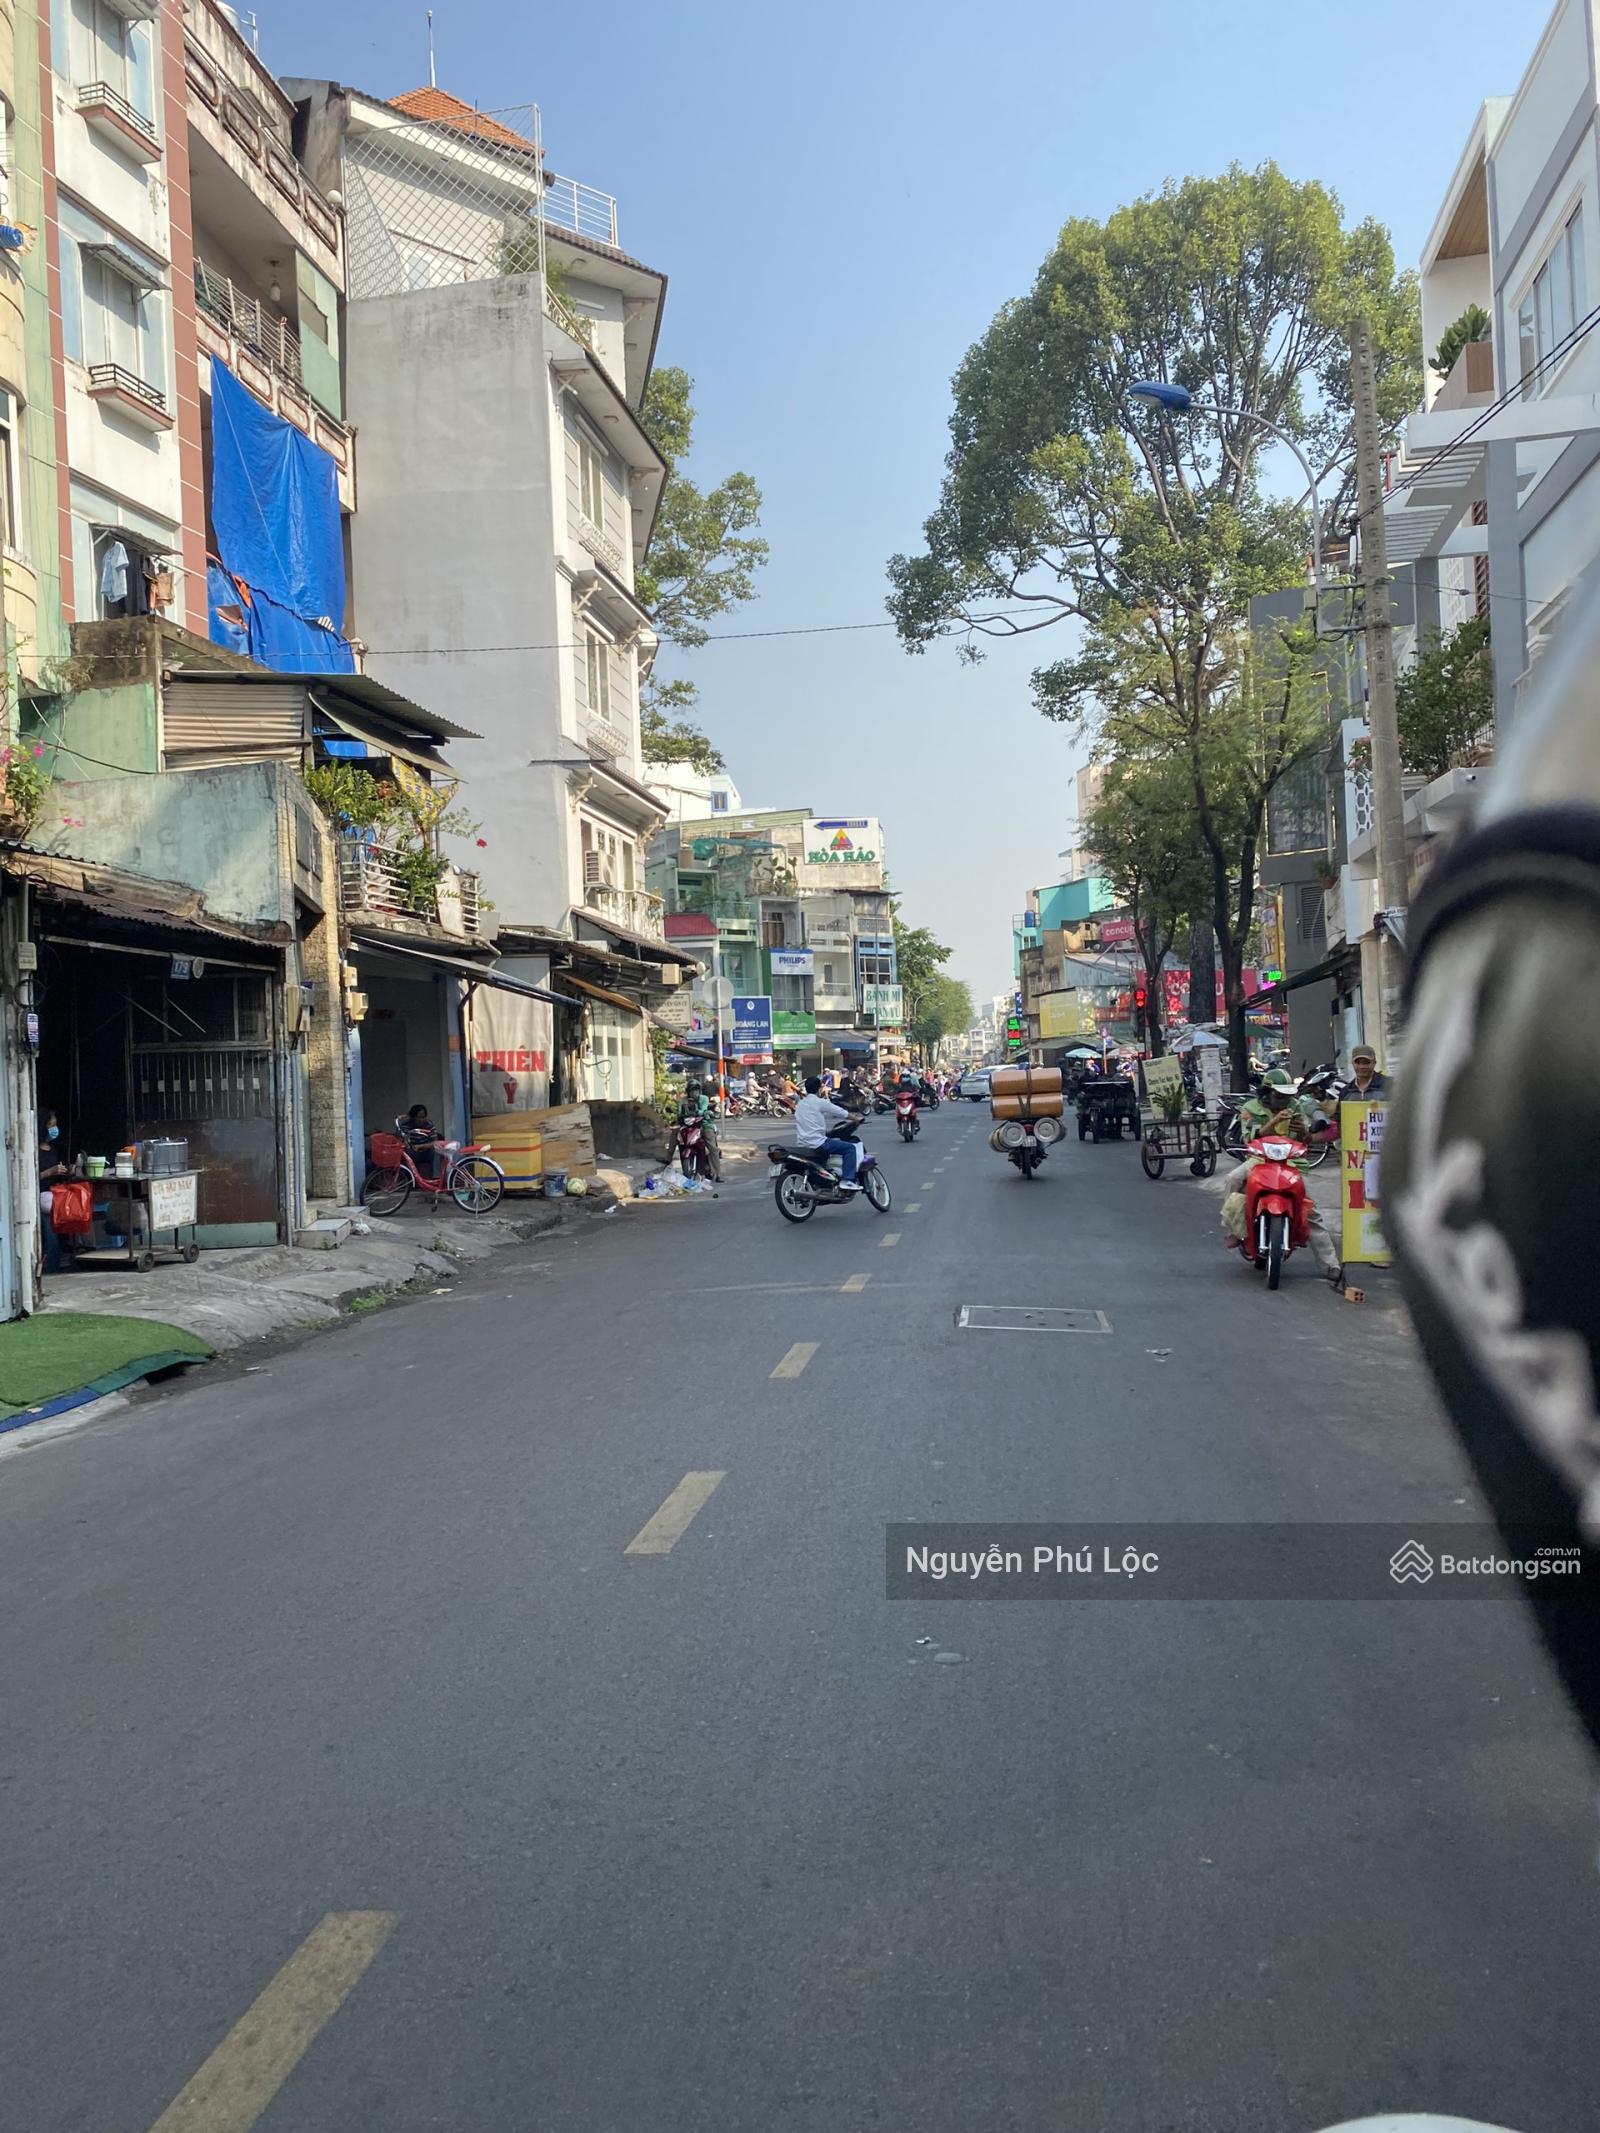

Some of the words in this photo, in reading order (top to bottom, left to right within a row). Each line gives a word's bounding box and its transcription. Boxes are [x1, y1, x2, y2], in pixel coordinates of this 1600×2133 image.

[808, 847, 840, 863] HÒA
[843, 846, 875, 862] HẢO
[174, 961, 189, 974] 179
[778, 956, 806, 964] PHILIPS
[475, 1045, 546, 1072] THIÊN
